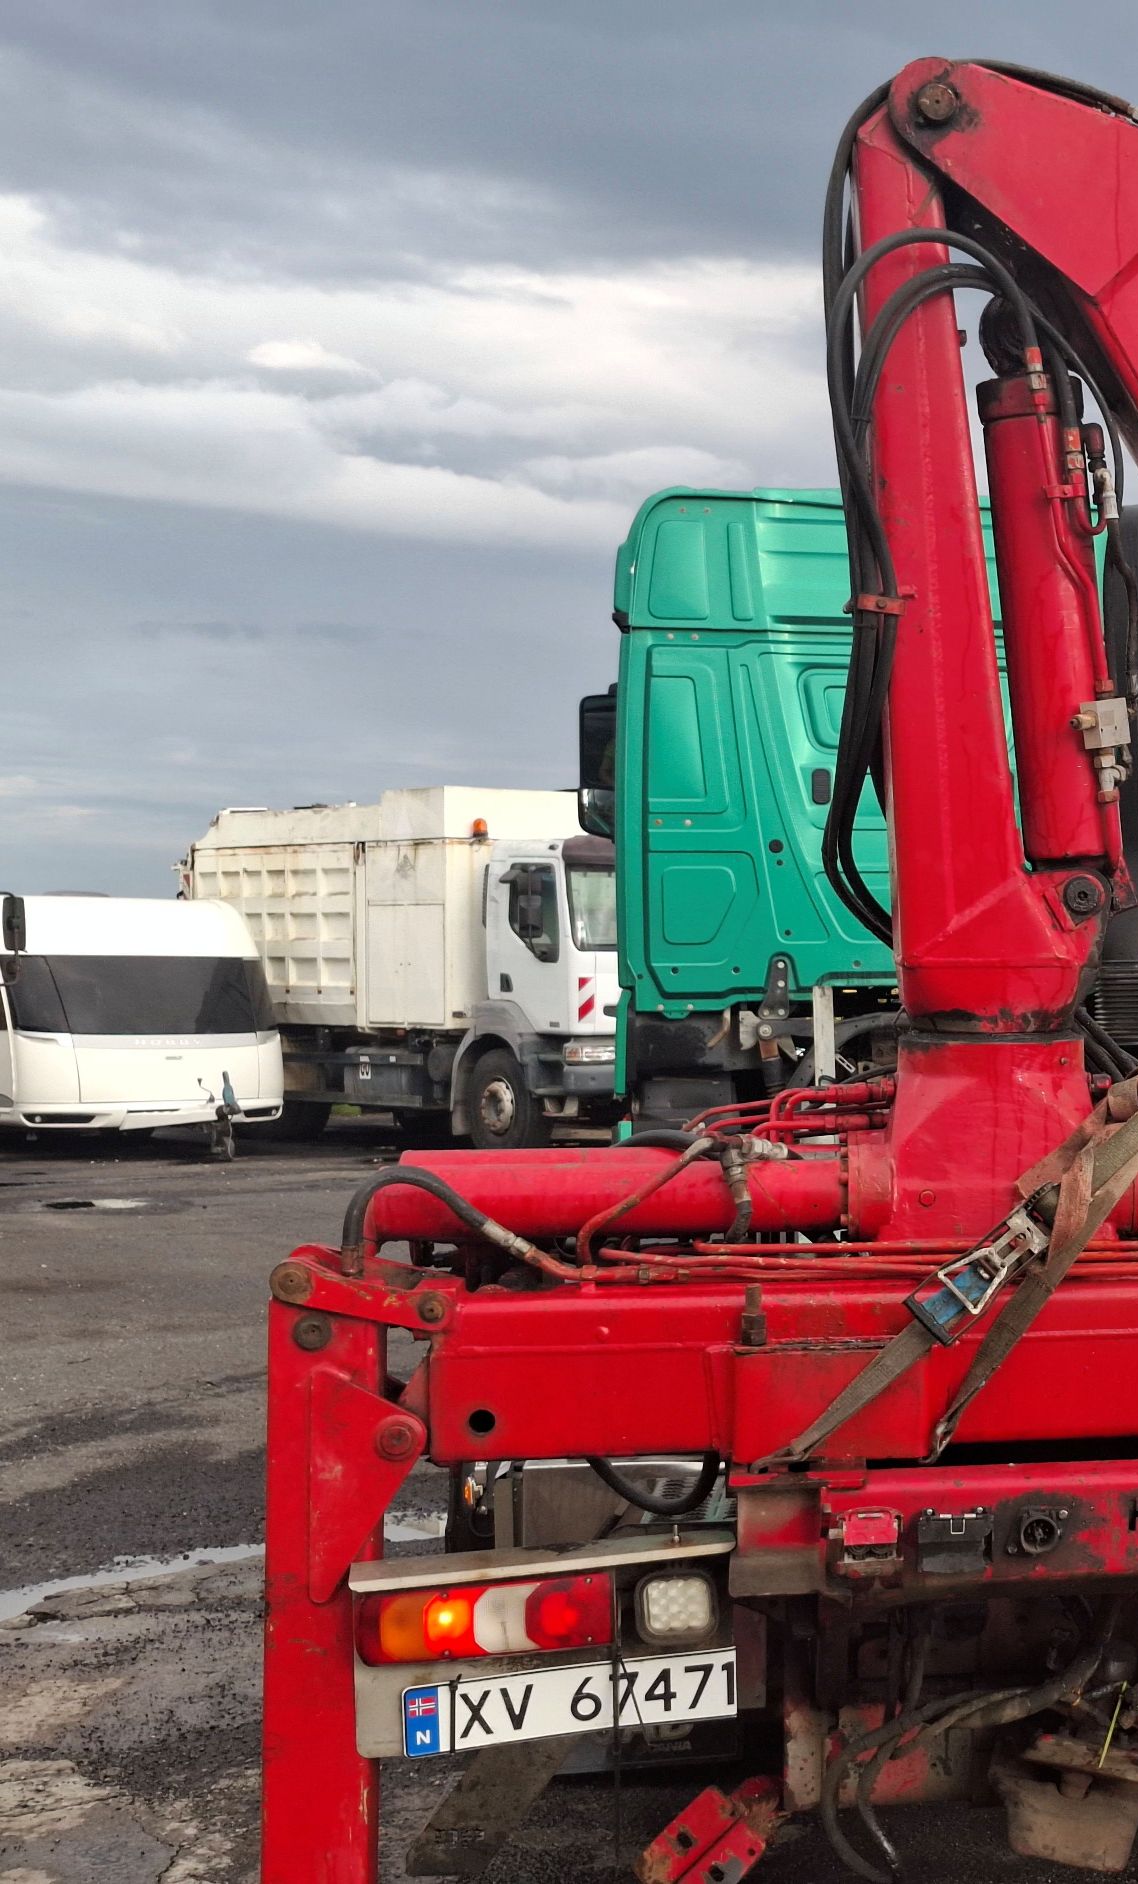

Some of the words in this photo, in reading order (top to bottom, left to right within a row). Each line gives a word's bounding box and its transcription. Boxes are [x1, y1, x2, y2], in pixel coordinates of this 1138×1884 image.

[460, 1684, 534, 1739] XV
[570, 1661, 735, 1721] 67471
[416, 1730, 430, 1745] N
